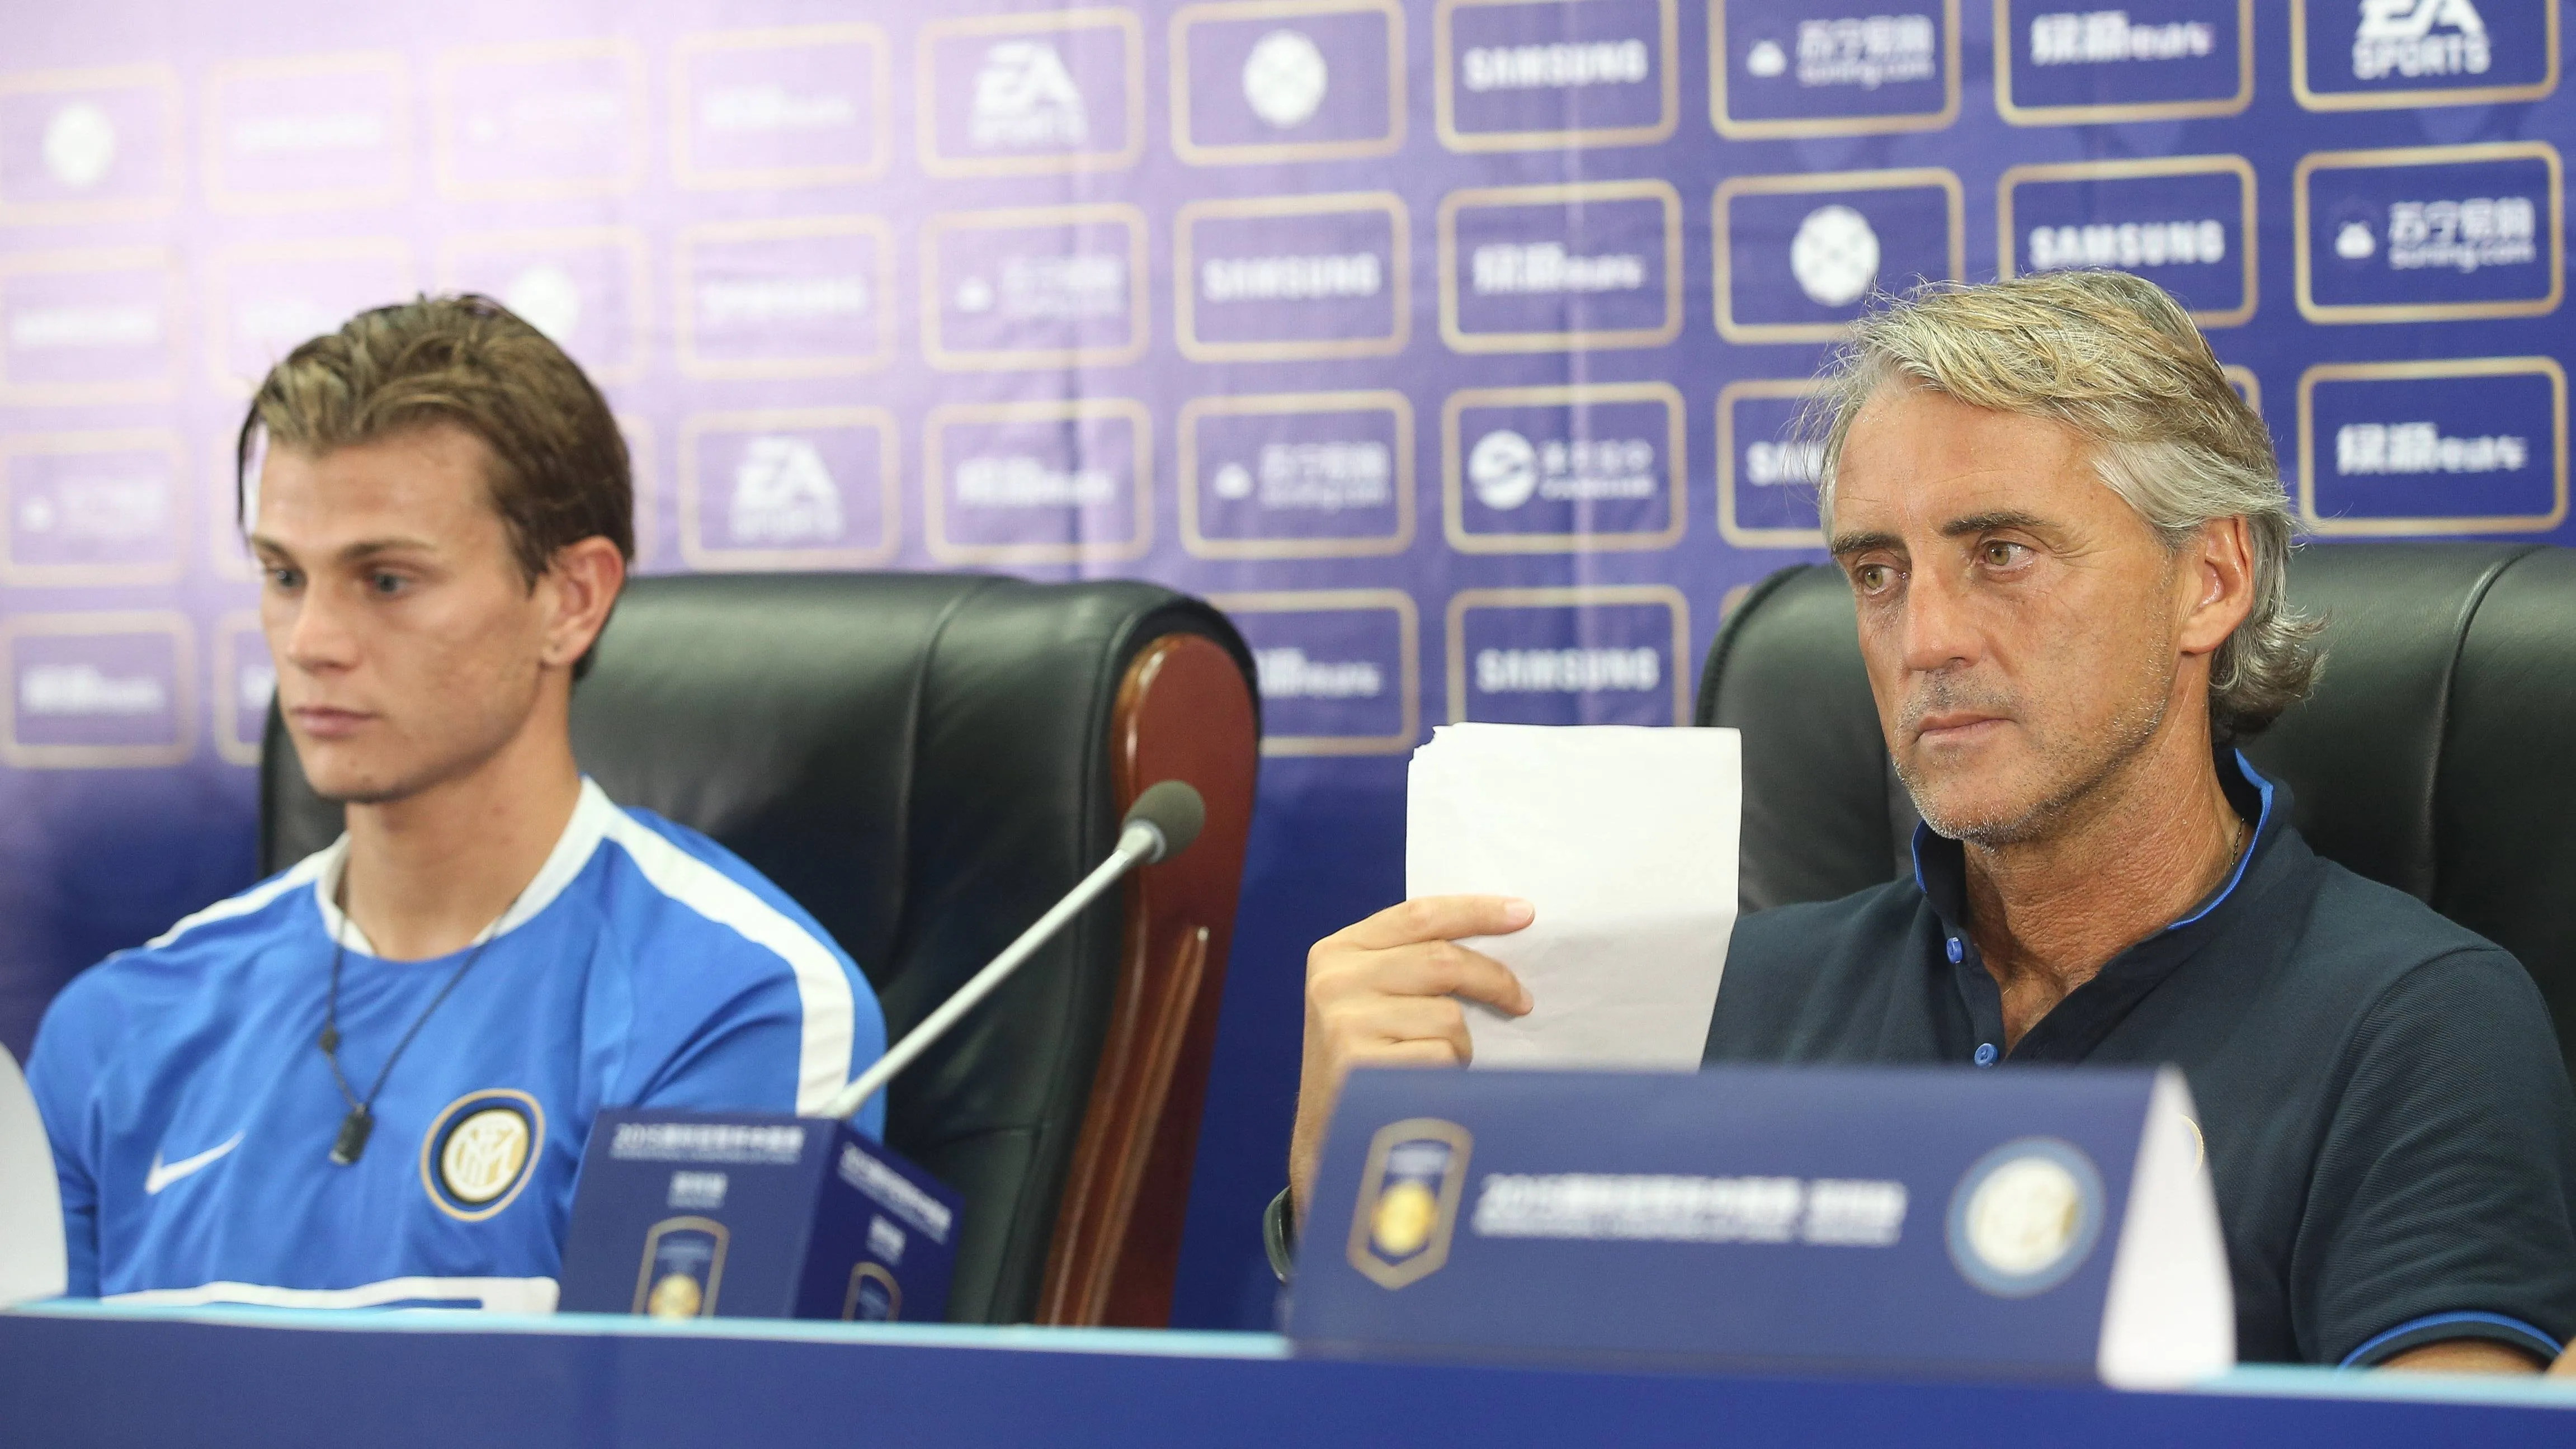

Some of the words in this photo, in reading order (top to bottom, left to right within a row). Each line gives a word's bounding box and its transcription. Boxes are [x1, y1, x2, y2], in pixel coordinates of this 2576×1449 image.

[1463, 40, 1647, 91] SAMSUNG
[2353, 36, 2489, 78] SPORTS
[2030, 221, 2225, 268] SAMSUNG
[1204, 253, 1381, 302] SAMSUNG
[1476, 648, 1659, 694] SAMSUNG
